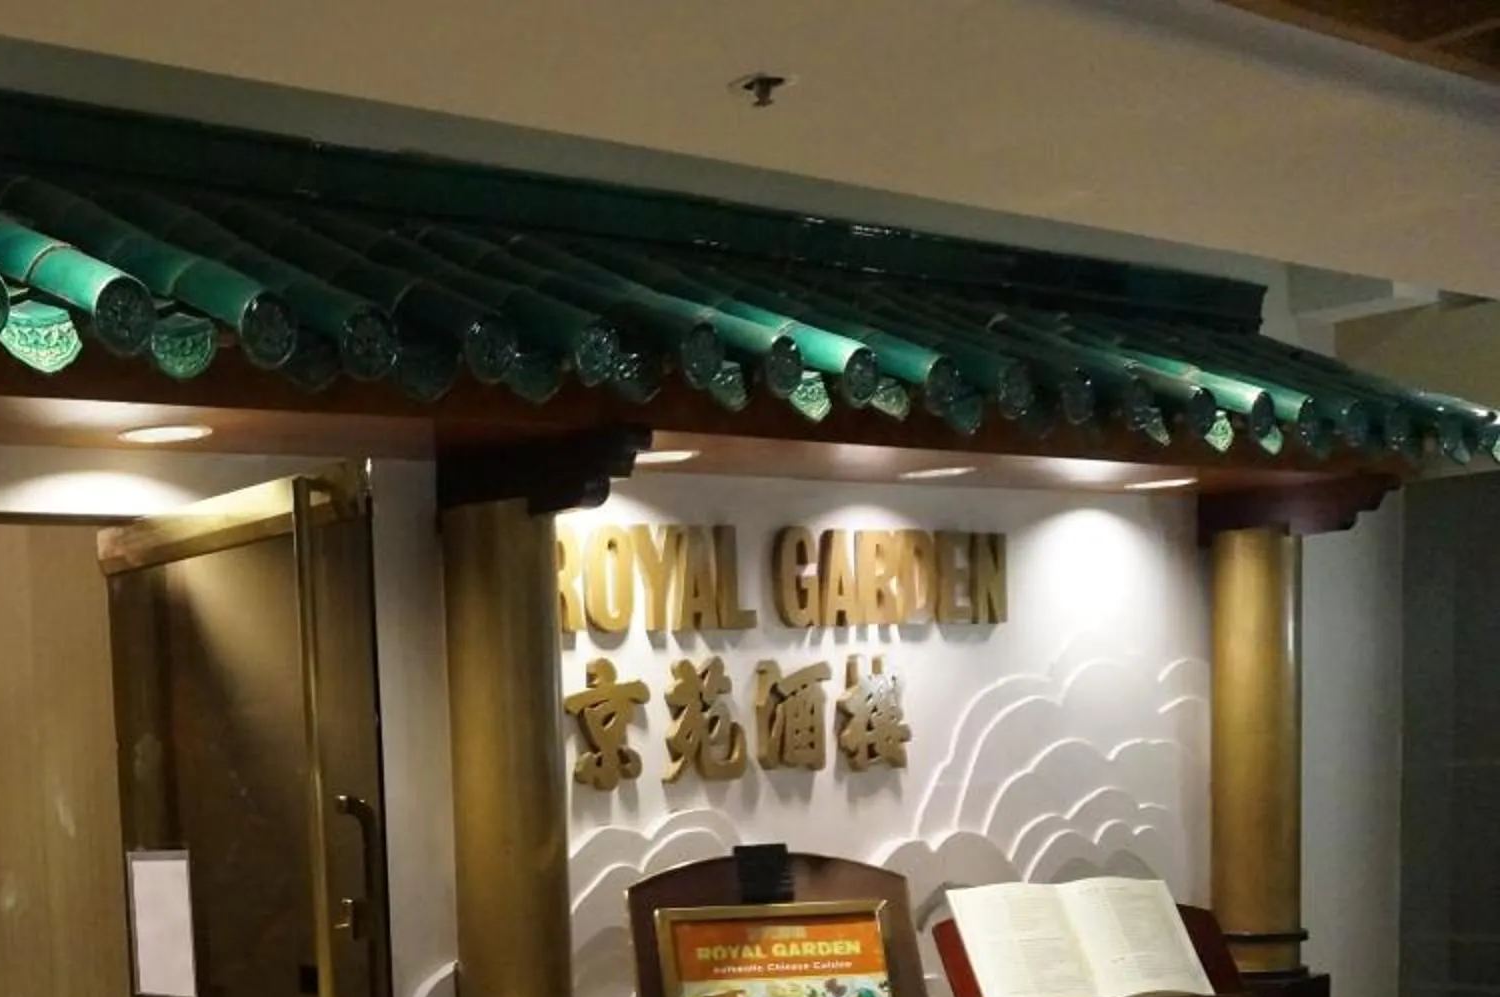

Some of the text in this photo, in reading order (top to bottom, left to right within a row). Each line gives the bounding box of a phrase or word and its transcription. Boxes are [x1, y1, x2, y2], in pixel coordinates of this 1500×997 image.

[556, 523, 1008, 633] ROYAL GARDEN
[695, 940, 861, 960] ROYAL GARDEN
[767, 961, 810, 972] Chinese
